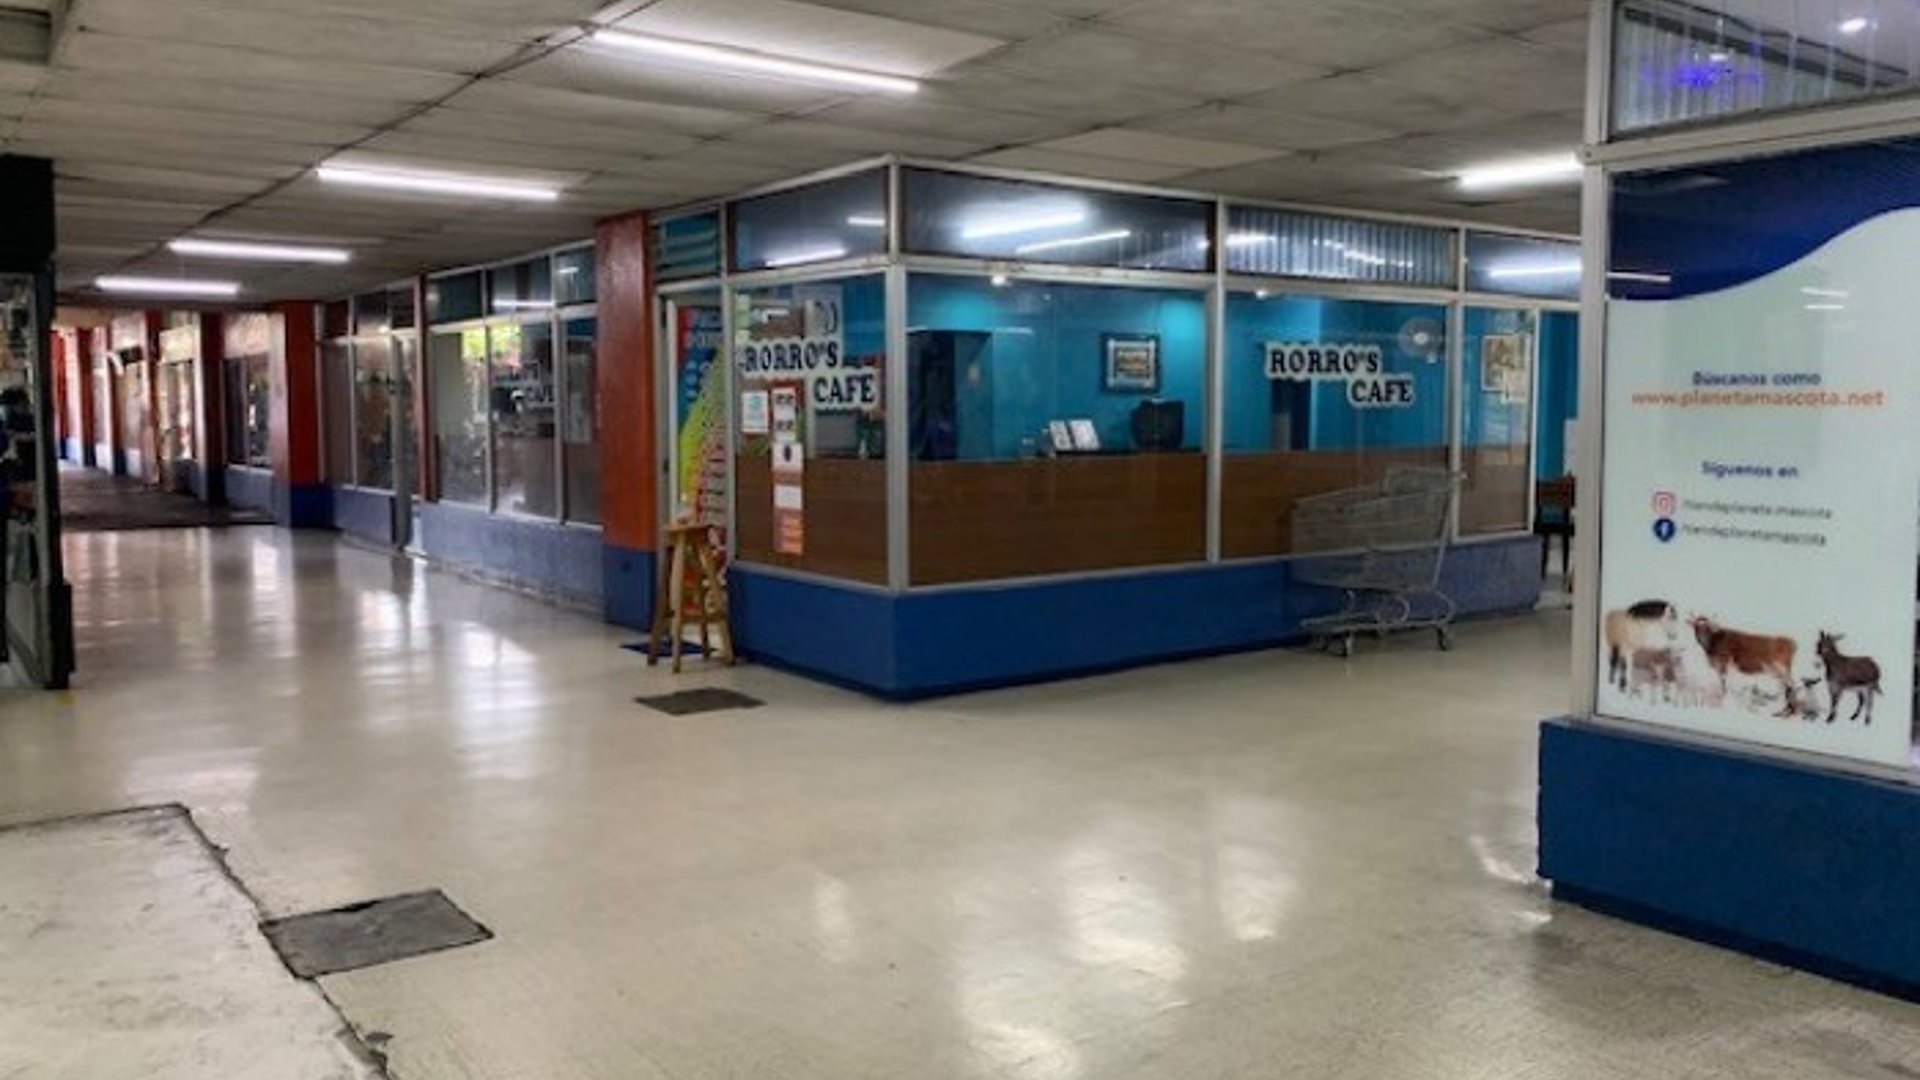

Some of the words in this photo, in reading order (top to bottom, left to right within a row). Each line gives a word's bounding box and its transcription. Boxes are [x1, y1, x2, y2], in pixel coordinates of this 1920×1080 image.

[744, 341, 838, 372] RORRO'S
[1270, 350, 1379, 373] RORRO'S
[814, 374, 874, 403] CAFE
[1351, 379, 1413, 402] CAFE
[1772, 372, 1822, 386] como
[1631, 389, 1885, 407] www.planetamascota.net
[1777, 466, 1798, 478] en
